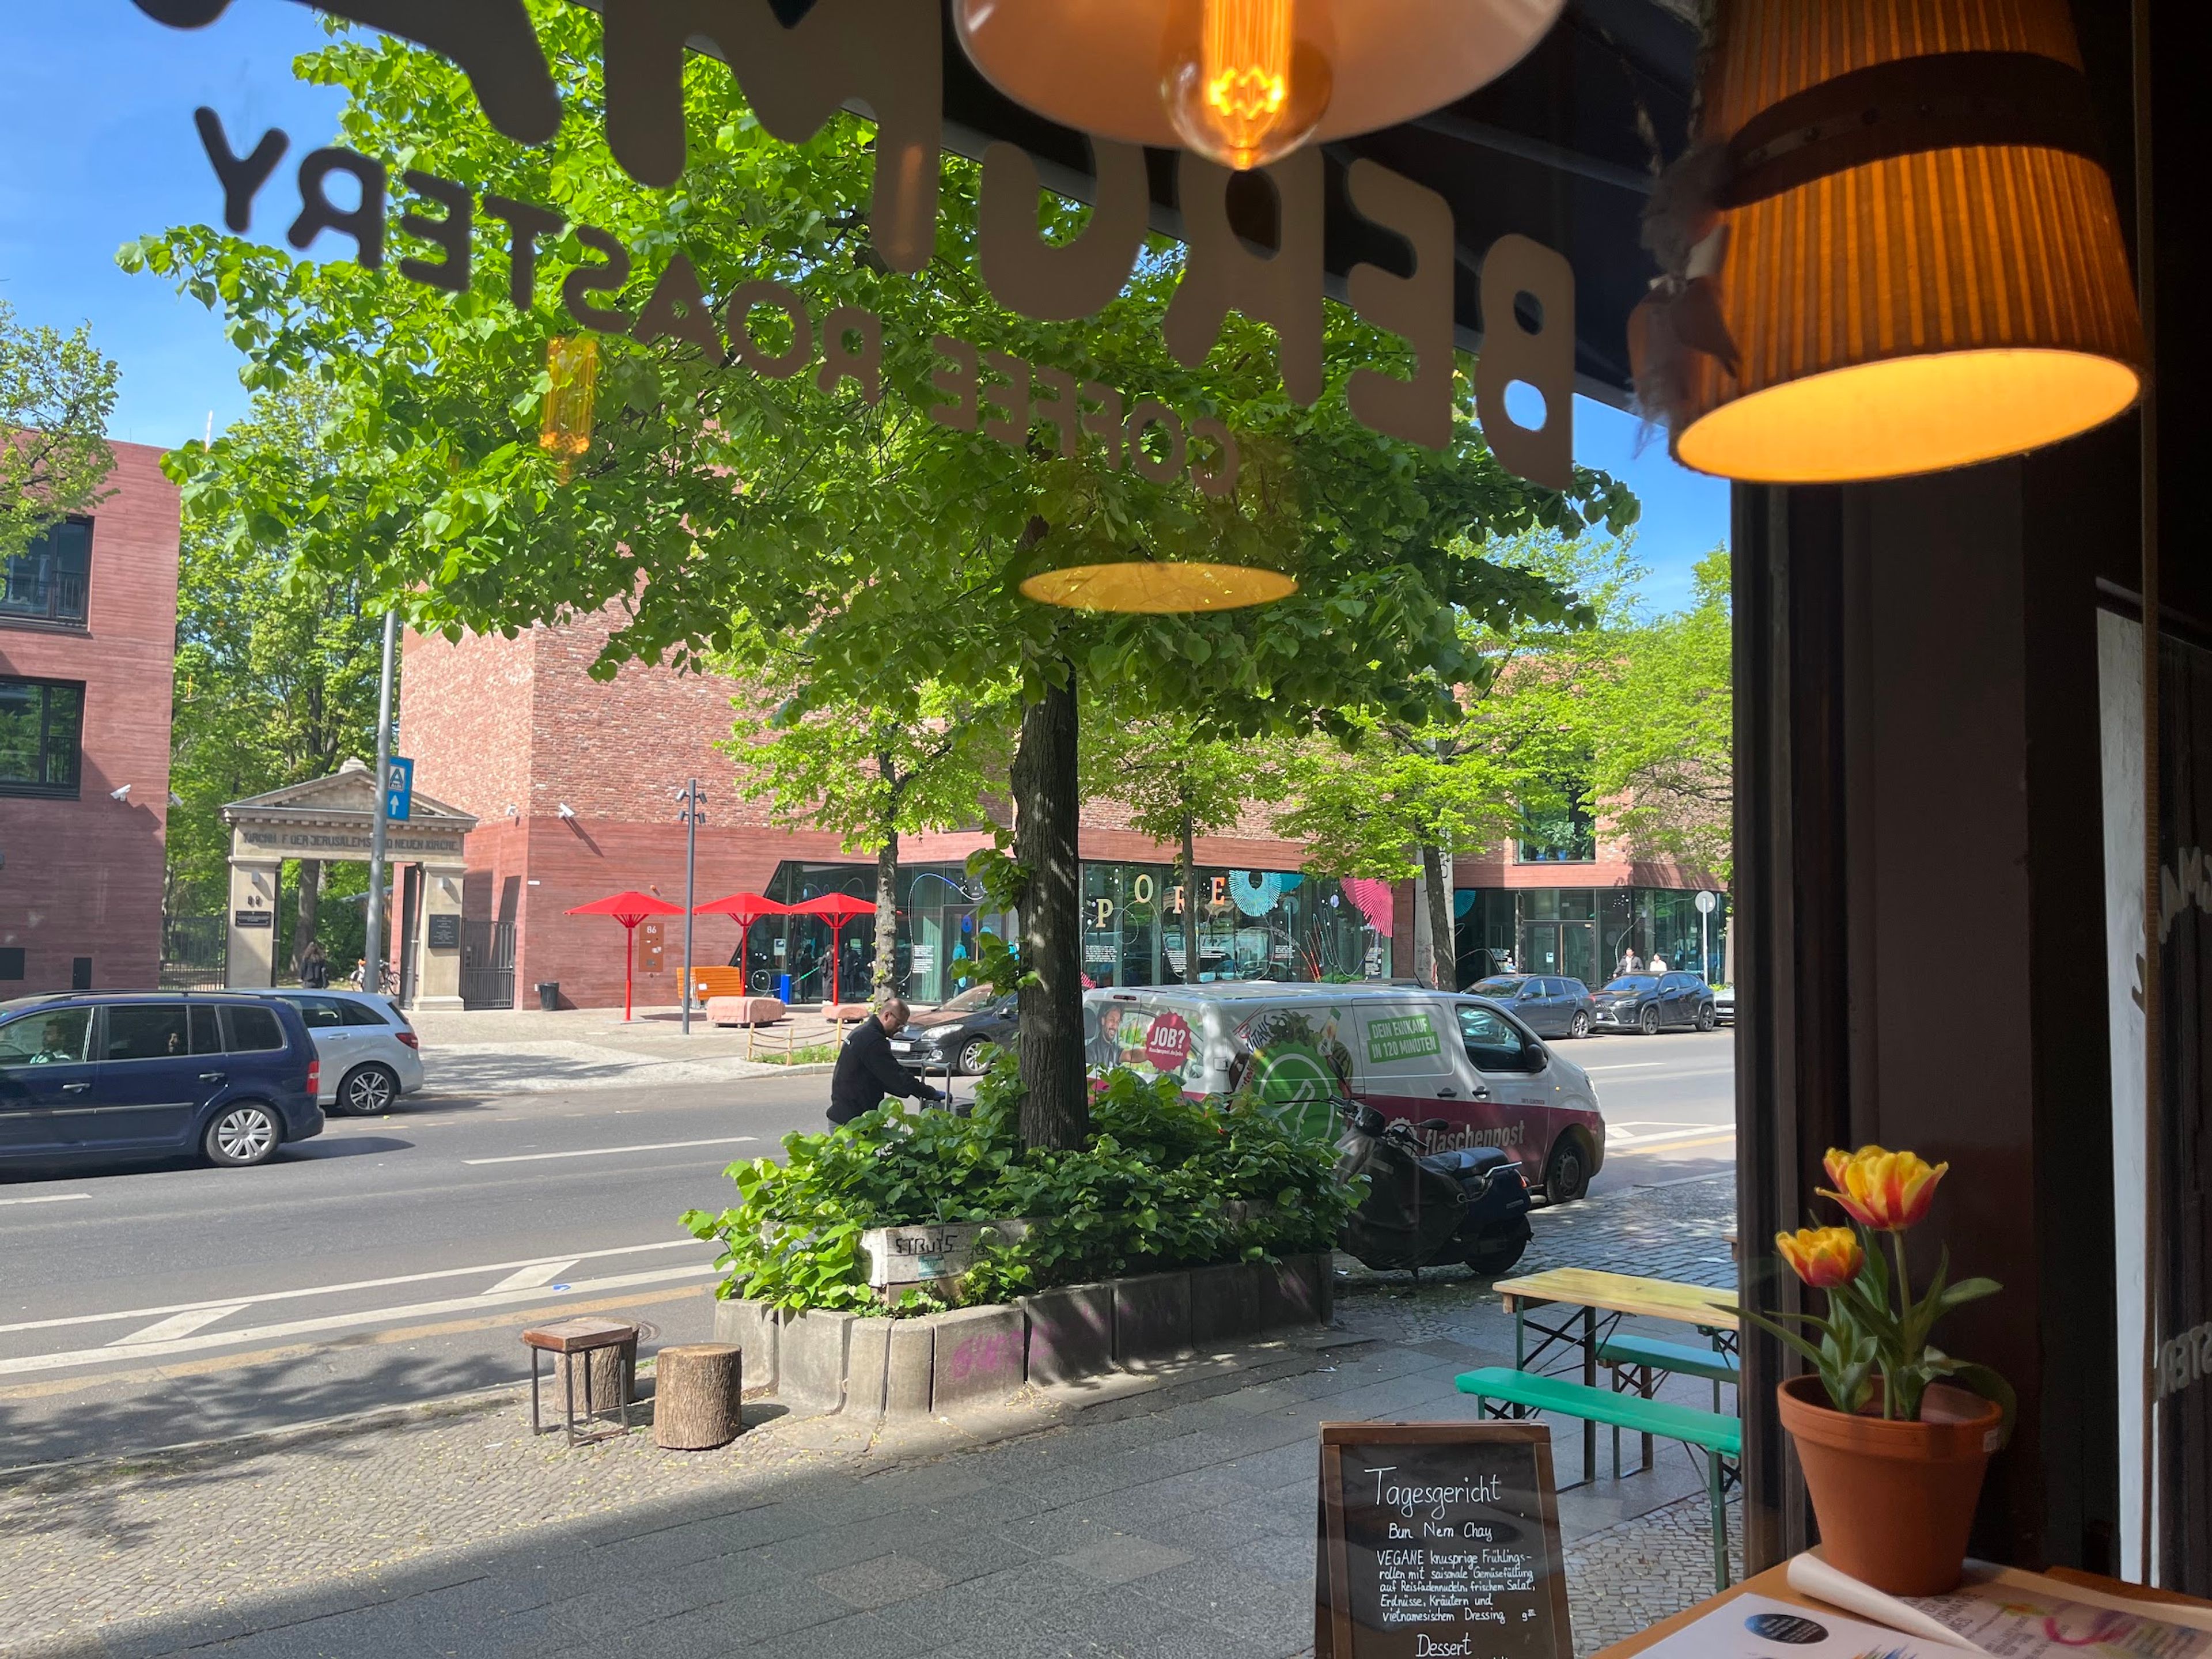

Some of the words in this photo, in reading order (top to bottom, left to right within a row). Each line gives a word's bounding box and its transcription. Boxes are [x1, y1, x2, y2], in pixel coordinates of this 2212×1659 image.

[244, 833, 288, 844] KIRCHHF
[290, 834, 308, 846] DER
[395, 839, 423, 850] NEUEN
[646, 925, 657, 934] 86
[1150, 1027, 1186, 1049] JOB?
[1372, 1022, 1392, 1039] DEIN
[1392, 1018, 1428, 1036] EINKAUF
[1372, 1043, 1382, 1058] IN
[1382, 1041, 1399, 1056] 120
[1399, 1036, 1437, 1054] MINUTEN
[1425, 1120, 1525, 1157] flaschenpost
[1364, 1466, 1501, 1519] Tagesgericht
[1388, 1524, 1414, 1540] Bun
[1423, 1522, 1454, 1537] Nem
[1464, 1522, 1493, 1542] Chay
[1377, 1550, 1424, 1566] VEGANE
[1430, 1550, 1478, 1570] knusprige
[1483, 1549, 1532, 1570] Frühlings-
[1380, 1566, 1406, 1580] rollen
[1408, 1566, 1425, 1580] mit
[1431, 1566, 1468, 1580] saisonale
[1473, 1566, 1533, 1582] Gemüsefüllung
[1380, 1580, 1397, 1592] auf
[1470, 1580, 1505, 1592] frischem
[1507, 1579, 1536, 1592] Salat,
[1429, 1594, 1469, 1607] Kräutern
[1475, 1593, 1493, 1605] und
[1382, 1607, 1456, 1622] vietnamesischem
[1464, 1607, 1505, 1624] Dressing
[1415, 1633, 1472, 1657] Dessert
